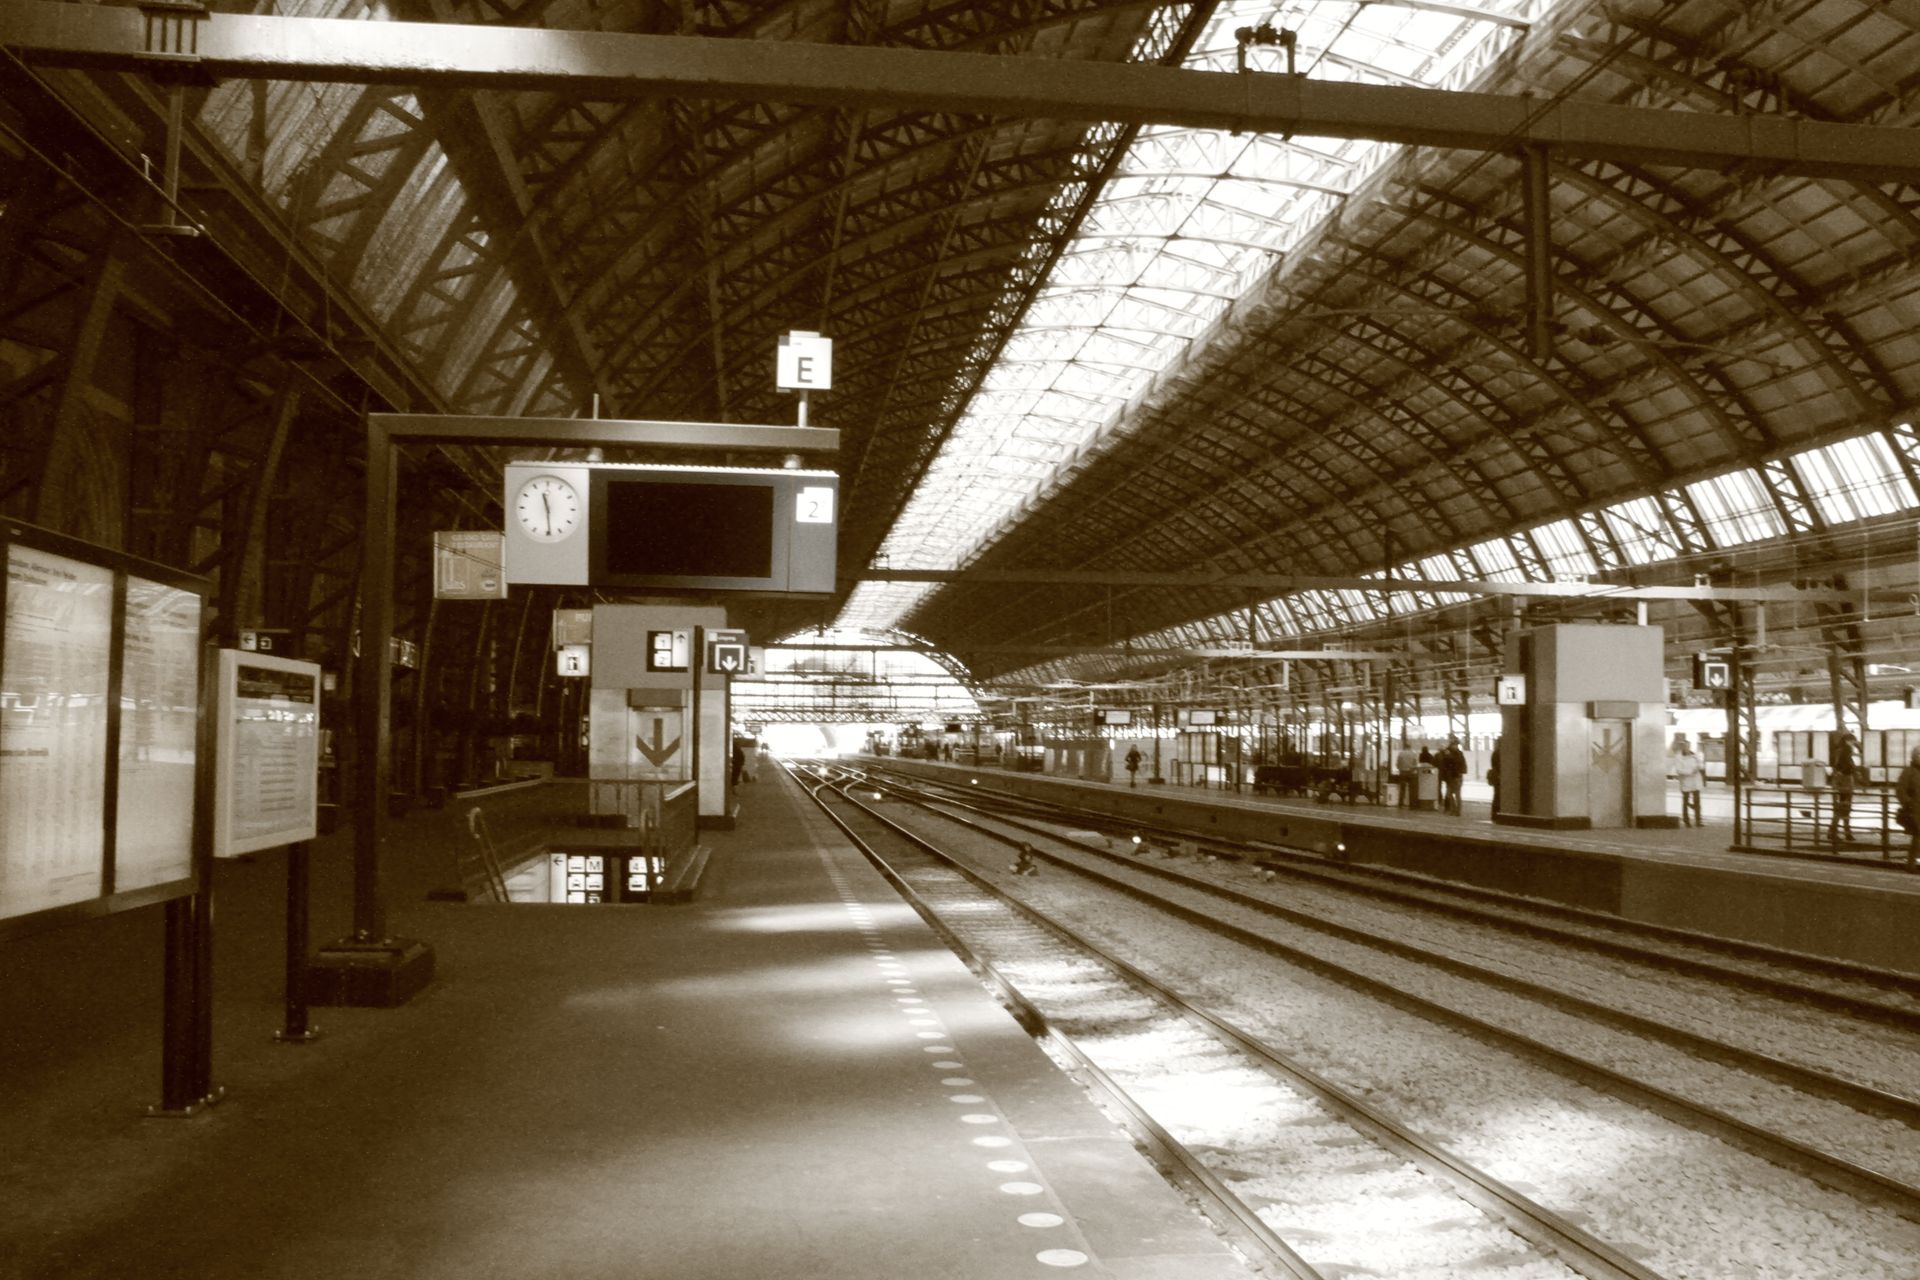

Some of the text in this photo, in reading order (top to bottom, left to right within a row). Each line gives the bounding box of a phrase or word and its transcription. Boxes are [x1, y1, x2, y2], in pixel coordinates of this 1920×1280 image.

[797, 356, 814, 383] E
[807, 500, 820, 519] 2
[589, 860, 601, 870] M
